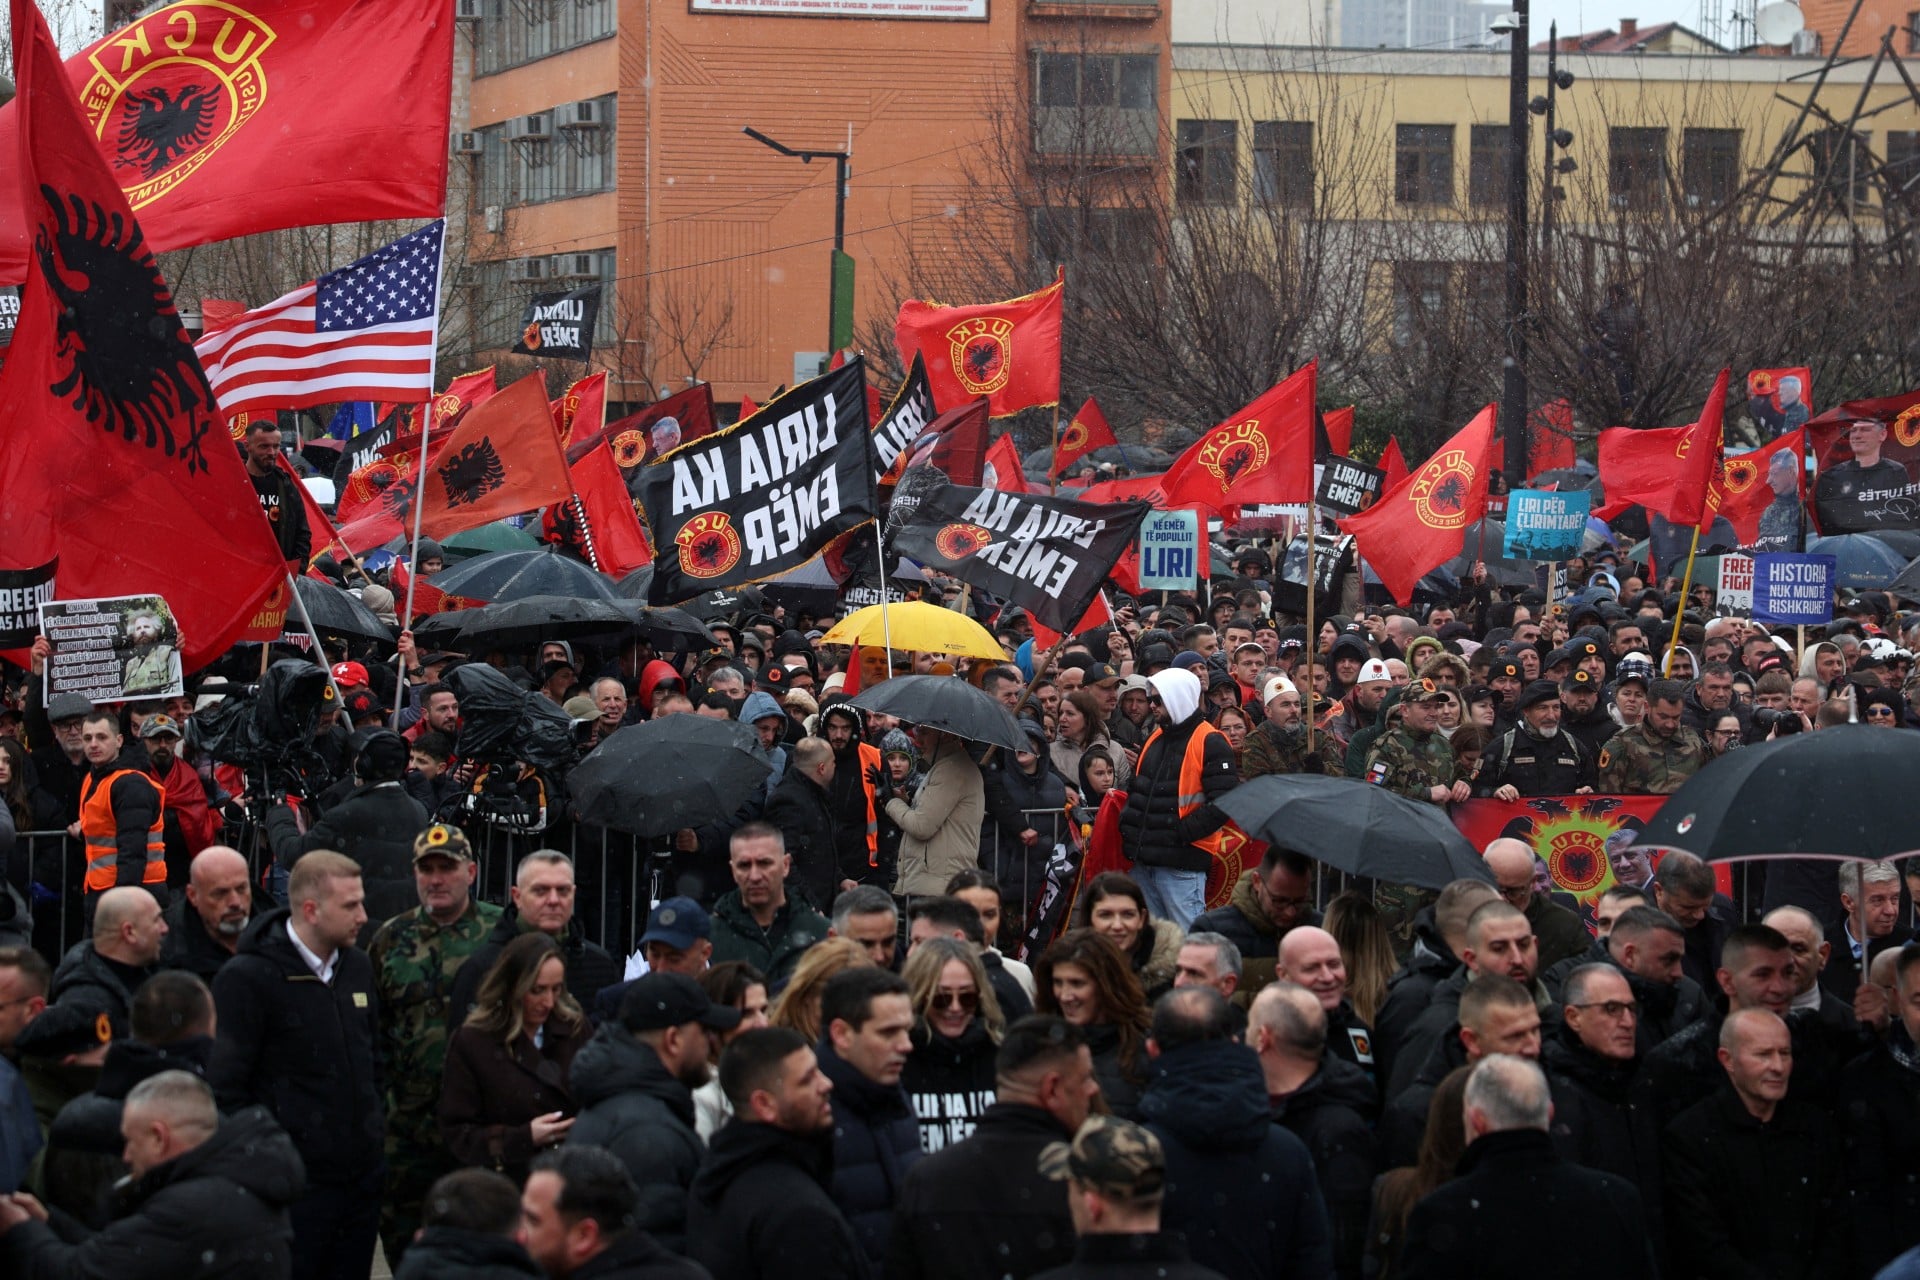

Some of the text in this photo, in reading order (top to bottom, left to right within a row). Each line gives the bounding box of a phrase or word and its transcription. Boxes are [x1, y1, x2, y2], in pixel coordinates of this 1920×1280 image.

[1333, 463, 1378, 492] LIRIA KA
[1327, 483, 1362, 508] EMËR
[1518, 497, 1541, 513] LIRI
[1543, 496, 1566, 514] PËR
[1153, 518, 1185, 530] NË EMËR
[1146, 530, 1192, 541] TË POPULLIT
[1144, 547, 1192, 577] LIRI
[1723, 558, 1754, 573] FREE
[1769, 562, 1826, 583] HISTORIA
[1722, 575, 1755, 591] FIGH
[0, 577, 56, 613] REEDO
[1769, 585, 1791, 598] NUK
[1793, 585, 1818, 599] MUND
[1769, 599, 1825, 615] RISHKRUHET
[0, 616, 13, 631] AS
[1554, 832, 1599, 849] UÇK
